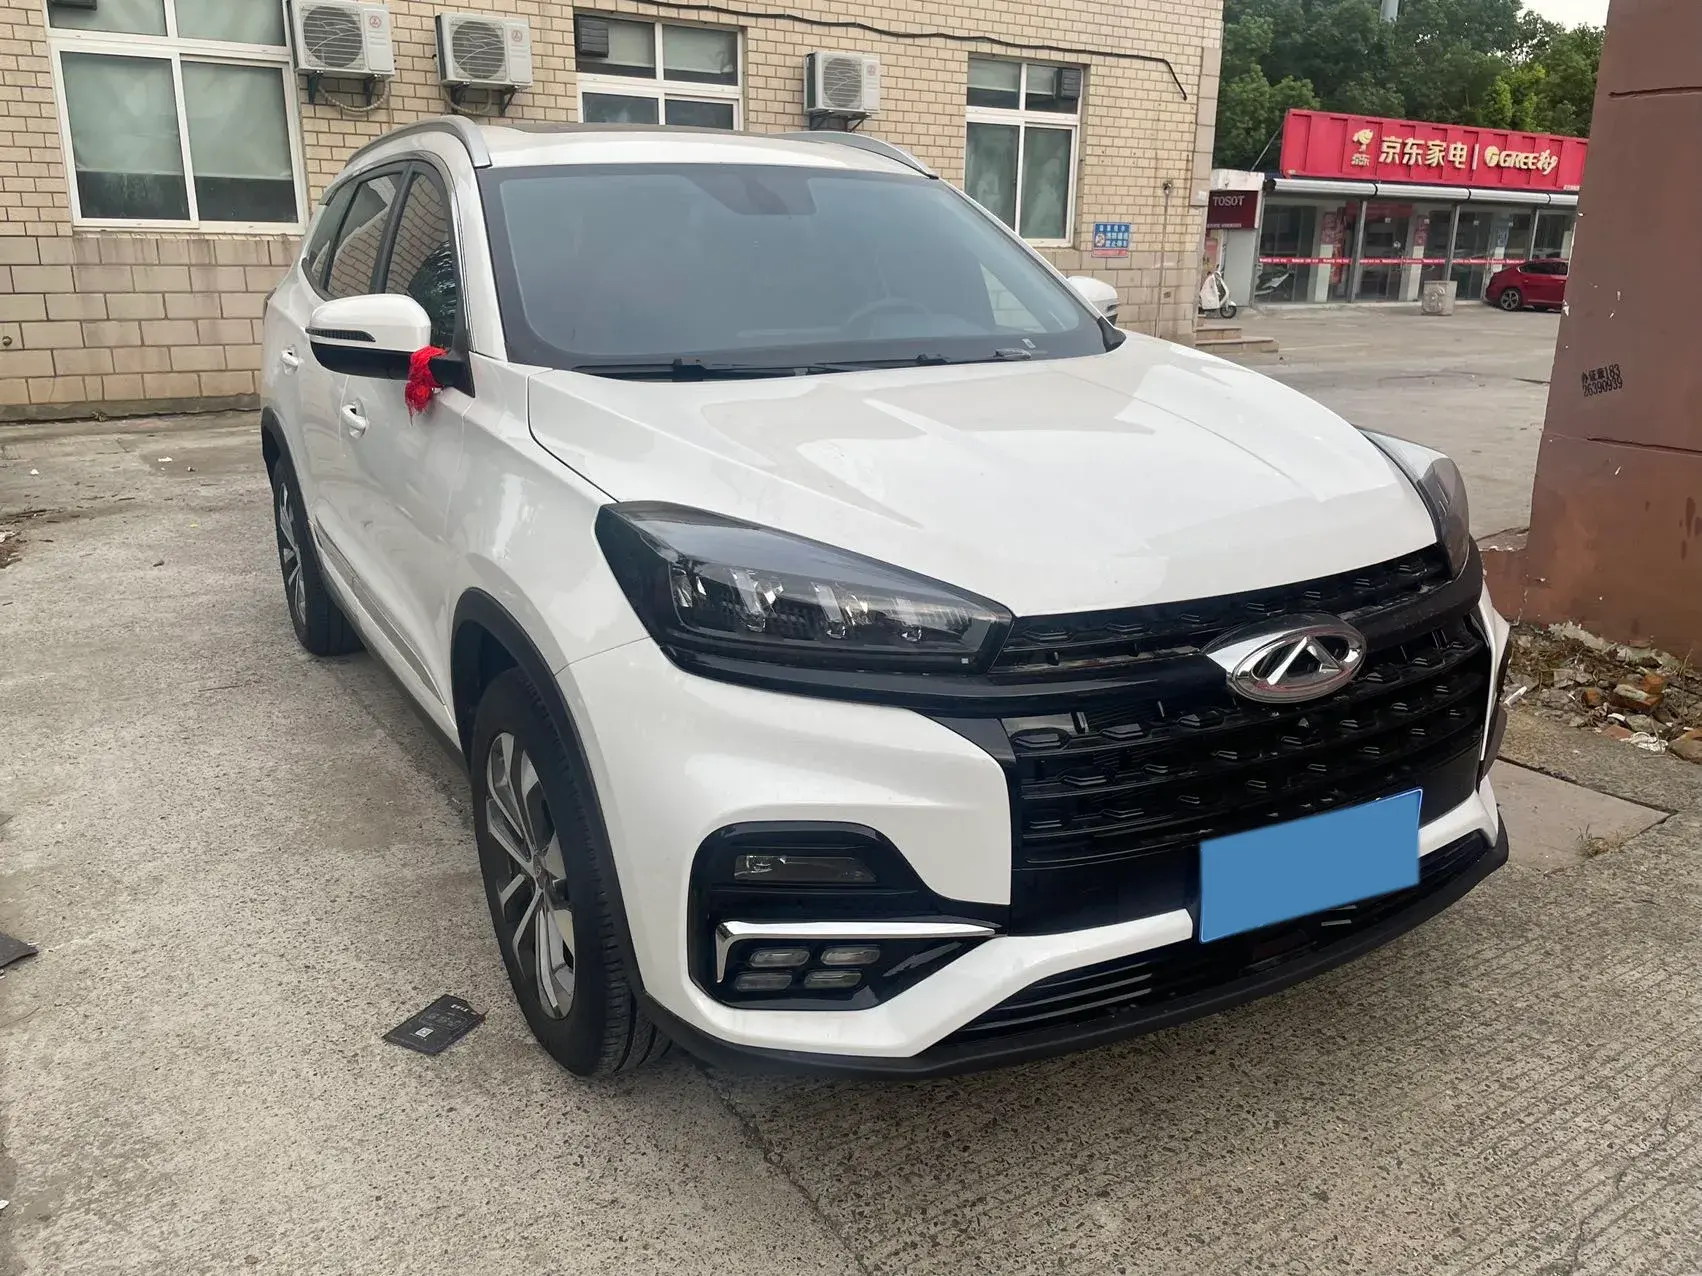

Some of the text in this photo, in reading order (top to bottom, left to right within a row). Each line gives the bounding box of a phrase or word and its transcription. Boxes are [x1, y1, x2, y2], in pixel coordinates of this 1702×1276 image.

[1379, 136, 1466, 169] 京东家电
[1500, 150, 1540, 170] GREE
[1212, 195, 1246, 207] TOSOT
